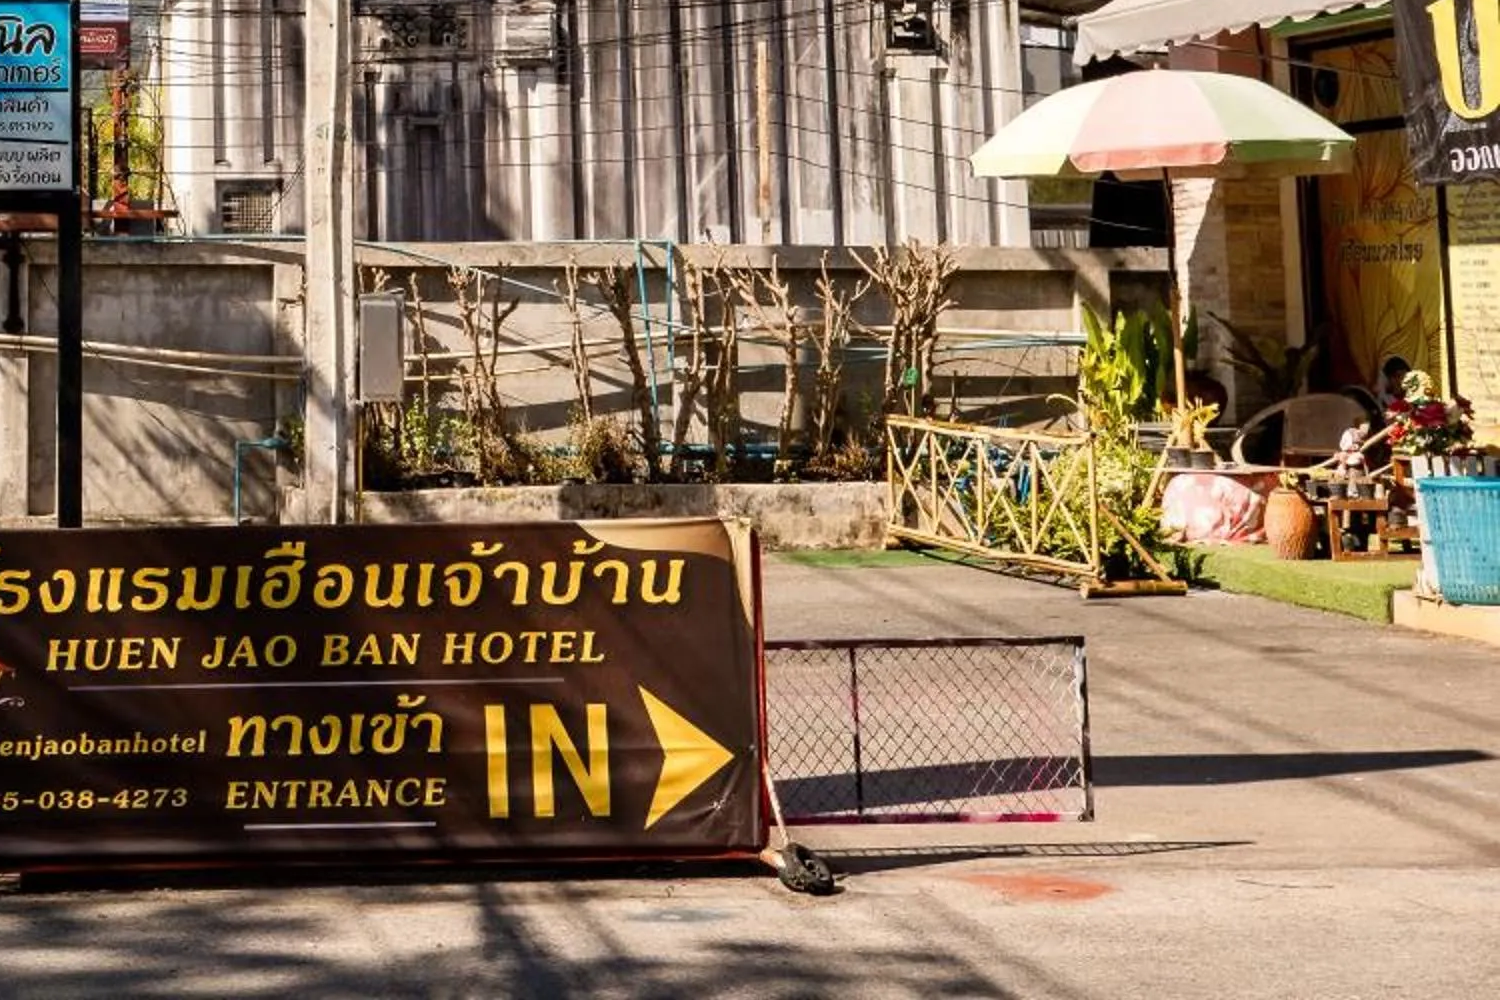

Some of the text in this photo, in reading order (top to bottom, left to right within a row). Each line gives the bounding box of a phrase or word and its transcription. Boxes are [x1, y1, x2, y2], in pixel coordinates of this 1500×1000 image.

[45, 631, 605, 671] HUEN JAO BAN HOTEL
[227, 695, 443, 758] ทางเข้า
[484, 703, 611, 819] IN
[225, 777, 446, 810] ENTRANCE
